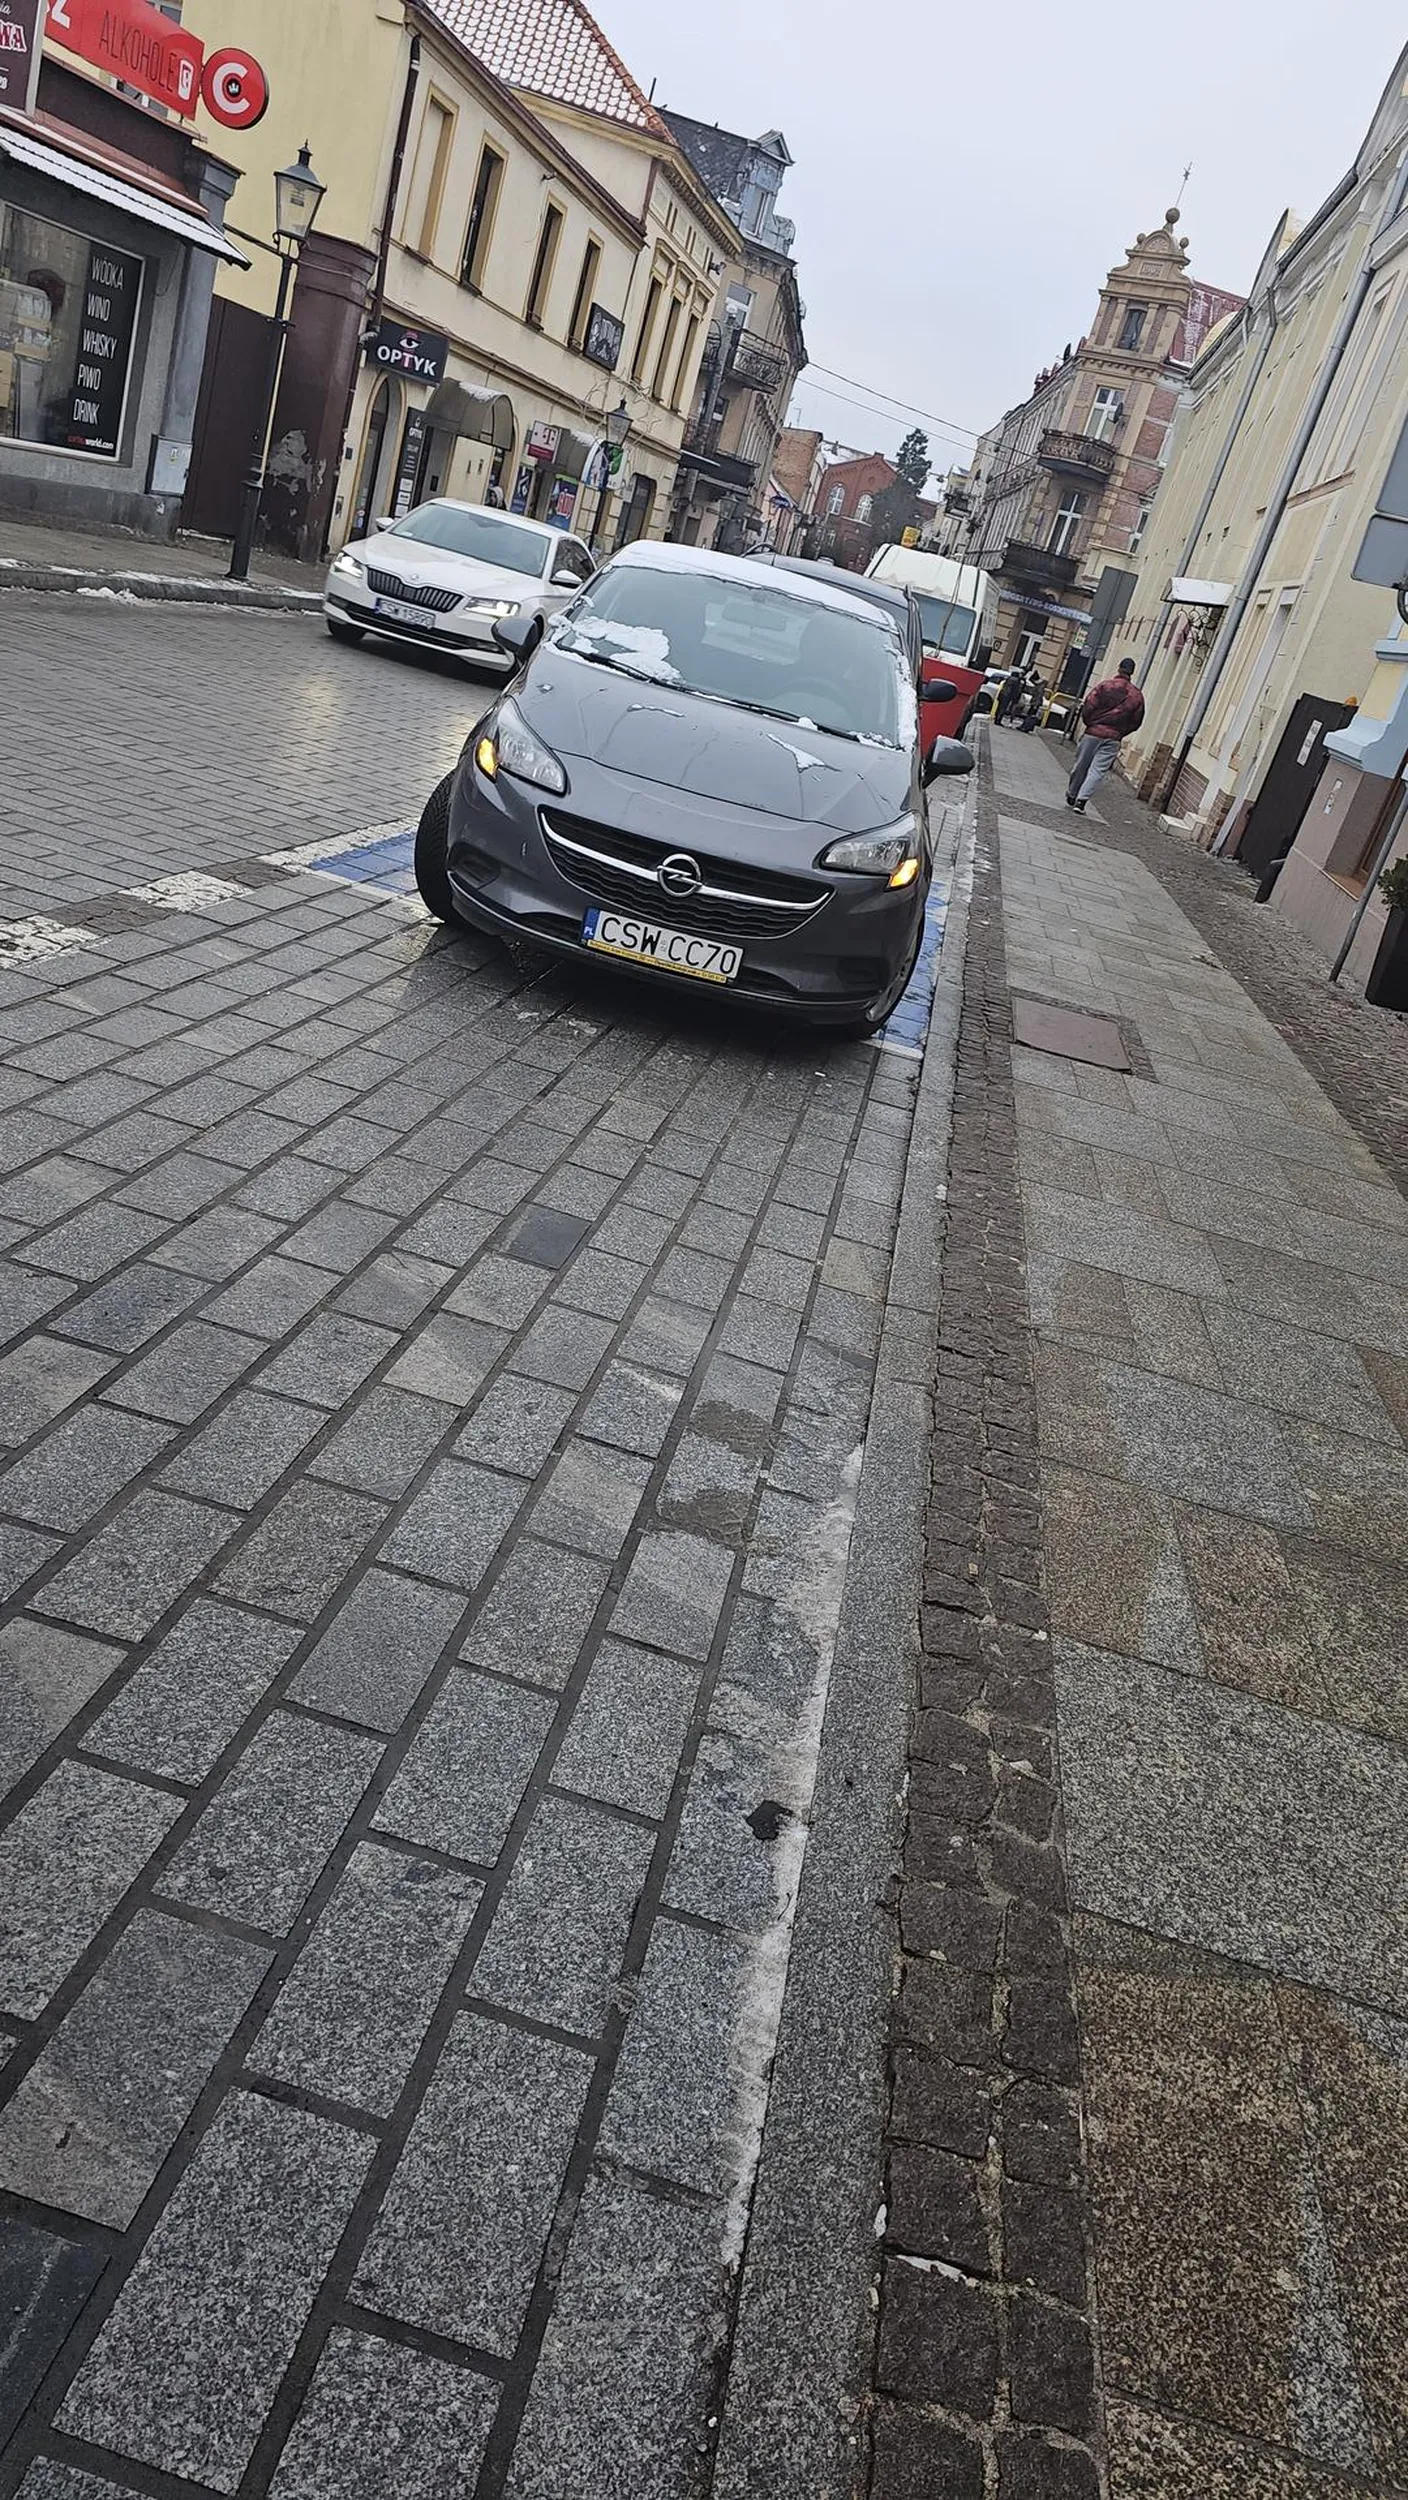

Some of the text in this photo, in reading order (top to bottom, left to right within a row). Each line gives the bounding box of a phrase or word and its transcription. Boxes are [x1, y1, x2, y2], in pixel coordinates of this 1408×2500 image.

[99, 11, 175, 93] ALKOHOLE
[92, 257, 123, 290] WÓDKA
[87, 292, 111, 321] WINO
[83, 328, 118, 359] WHISKY
[377, 345, 437, 376] OPTYK
[77, 363, 101, 390] PIWO
[73, 398, 99, 425] DRINK
[583, 926, 594, 936] PL
[600, 917, 661, 956] CSW
[668, 936, 737, 974] CC70
